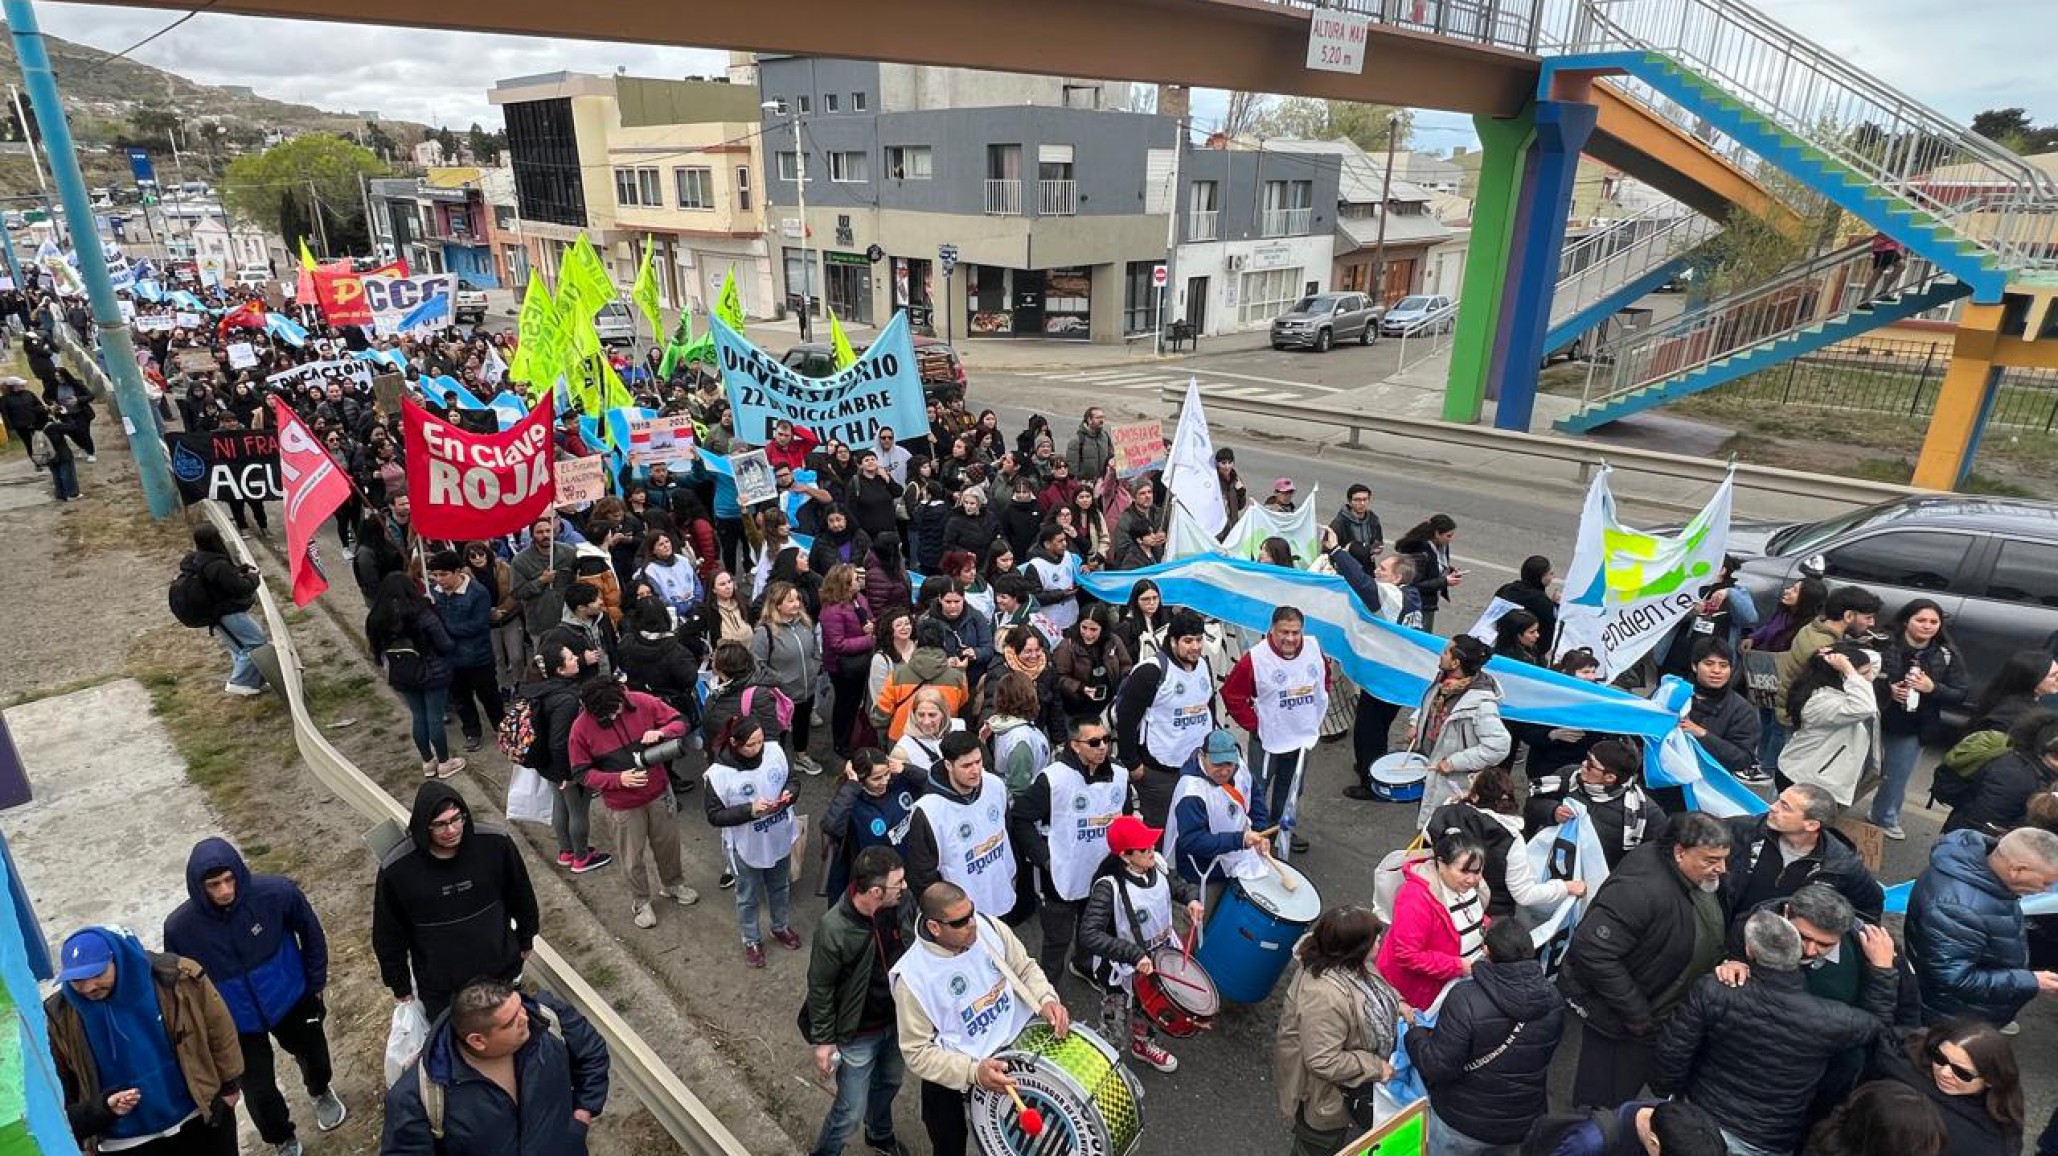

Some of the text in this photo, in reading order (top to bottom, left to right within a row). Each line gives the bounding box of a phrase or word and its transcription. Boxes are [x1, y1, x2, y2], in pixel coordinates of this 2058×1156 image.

[1313, 19, 1344, 40] ALTURA
[365, 278, 449, 312] CCC
[740, 386, 766, 407] 22
[213, 437, 237, 459] NI
[423, 422, 465, 462] En
[429, 450, 551, 510] ROJA
